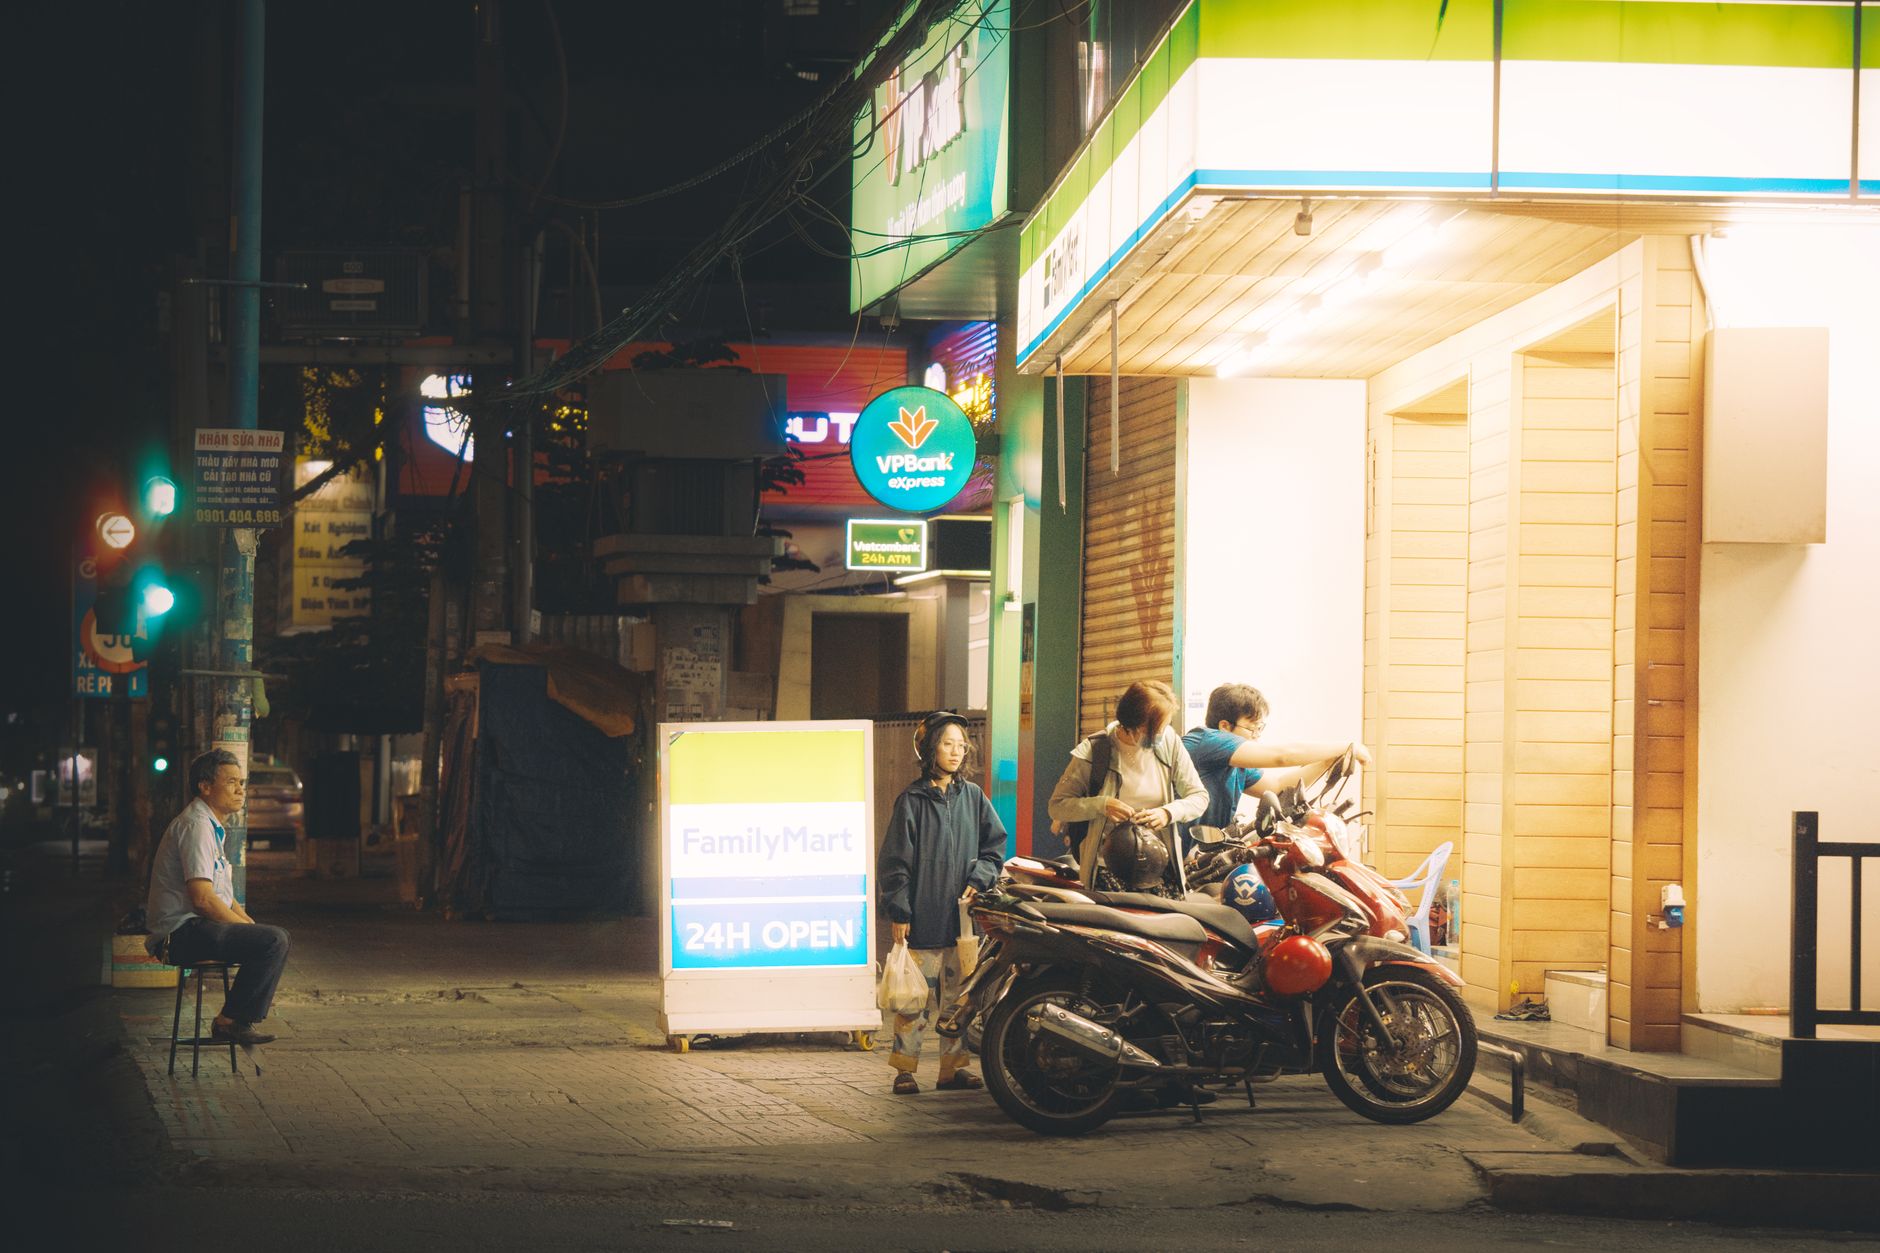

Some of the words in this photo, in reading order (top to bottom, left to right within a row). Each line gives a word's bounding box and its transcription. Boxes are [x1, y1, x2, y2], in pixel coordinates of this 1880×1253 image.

[876, 452, 954, 474] VPBank
[862, 553, 885, 564] 24h
[887, 553, 911, 564] ATM
[682, 826, 853, 861] FamilyMart
[686, 922, 750, 950] 24H
[762, 919, 853, 948] OPEN
